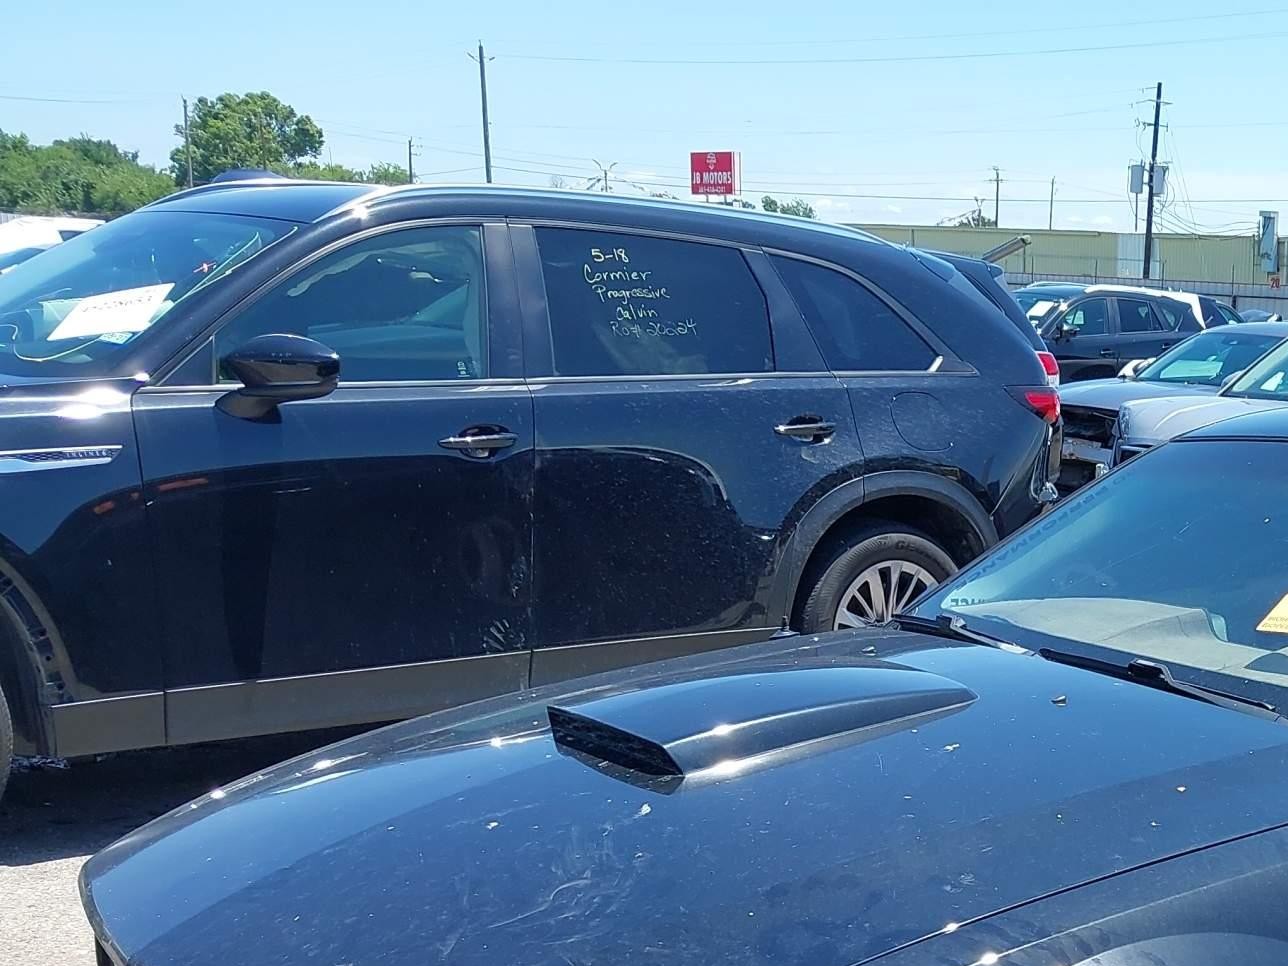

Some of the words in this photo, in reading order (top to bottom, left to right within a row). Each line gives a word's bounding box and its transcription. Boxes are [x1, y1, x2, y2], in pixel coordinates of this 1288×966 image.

[693, 171, 701, 184] JB
[702, 171, 732, 185] MOTORS
[591, 248, 629, 263] 5-18
[584, 264, 651, 283] Cormier
[1270, 277, 1281, 289] 20
[592, 285, 670, 304] Progressive
[616, 304, 657, 321] Calvin
